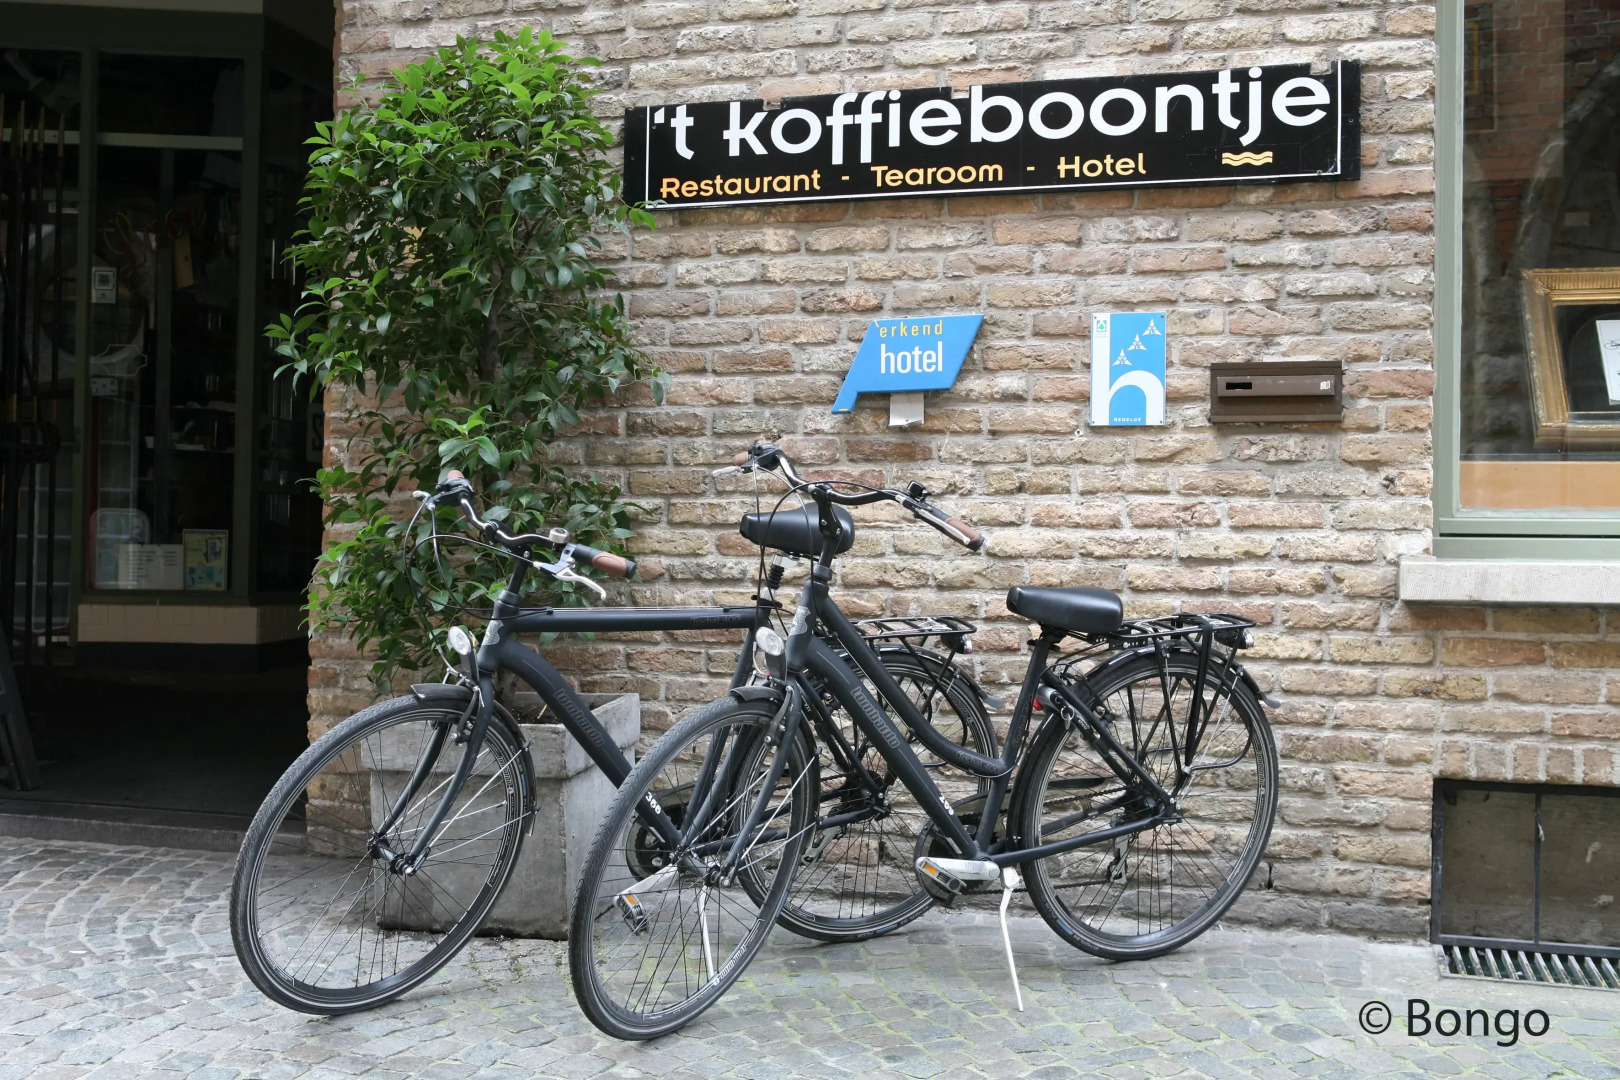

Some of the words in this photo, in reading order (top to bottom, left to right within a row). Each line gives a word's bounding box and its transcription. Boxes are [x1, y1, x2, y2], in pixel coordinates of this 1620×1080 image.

[723, 66, 1331, 165] koffieboontje
[660, 169, 821, 199] Restaurant
[870, 163, 1003, 188] Tearoom
[1057, 152, 1147, 179] Hotel
[879, 320, 943, 338] erkend
[880, 341, 943, 374] hotel
[552, 688, 606, 747] lombardo
[850, 686, 901, 749] lombardo
